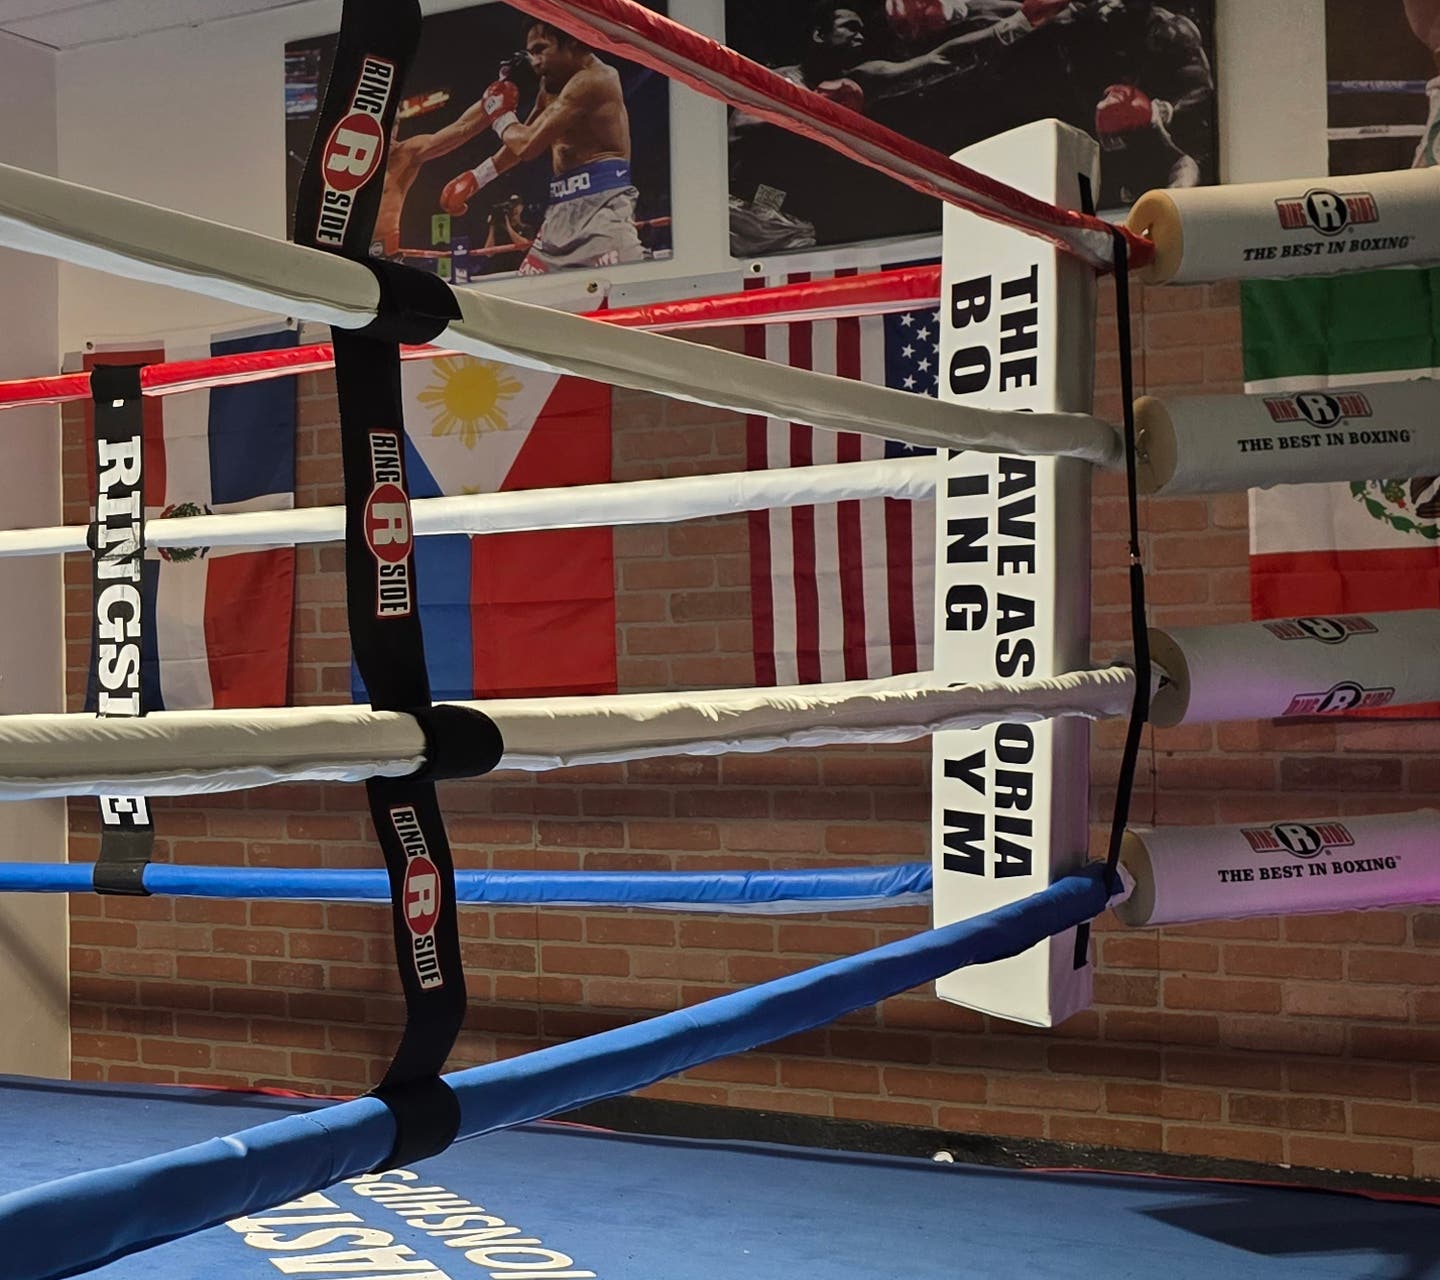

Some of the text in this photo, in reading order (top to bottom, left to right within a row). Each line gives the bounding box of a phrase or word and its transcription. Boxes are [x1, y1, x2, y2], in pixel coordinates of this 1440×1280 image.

[318, 60, 392, 244] RING R SIDE
[1243, 236, 1410, 261] THE BEST IN BOXING
[1309, 191, 1343, 229] R
[1238, 429, 1410, 453] THE BEST IN BOXING
[1300, 393, 1332, 421] R
[371, 435, 409, 613] RING R SIDE
[943, 274, 993, 877] BOING YM
[994, 263, 1039, 879] THE AVE ASORIA
[97, 435, 153, 825] RINGSIE
[1218, 856, 1397, 883] THE BEST IN BOXING
[1283, 823, 1317, 853] R
[392, 810, 441, 985] RING R SIDE
